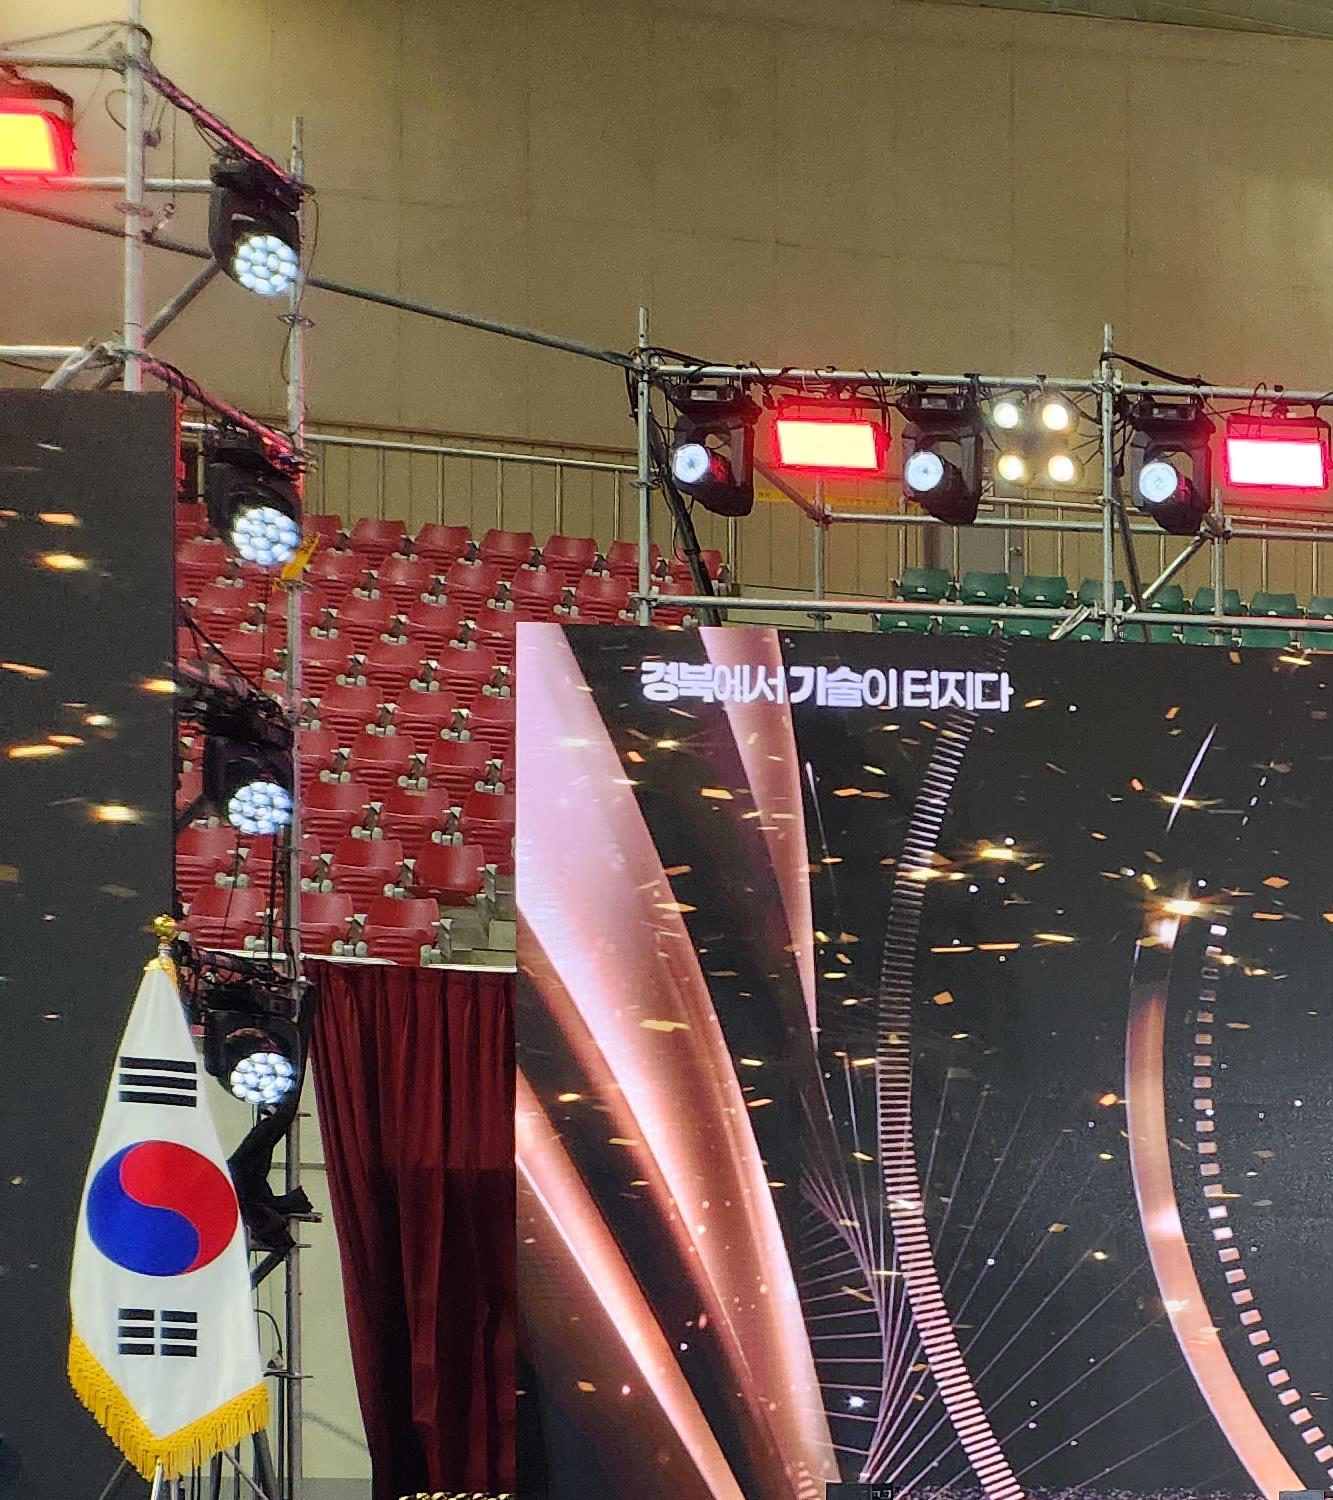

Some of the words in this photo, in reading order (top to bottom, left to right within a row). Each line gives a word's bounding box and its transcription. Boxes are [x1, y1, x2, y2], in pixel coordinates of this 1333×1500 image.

[641, 661, 784, 704] 경북에서
[789, 666, 897, 709] 기술이
[902, 670, 1014, 712] 터지다
